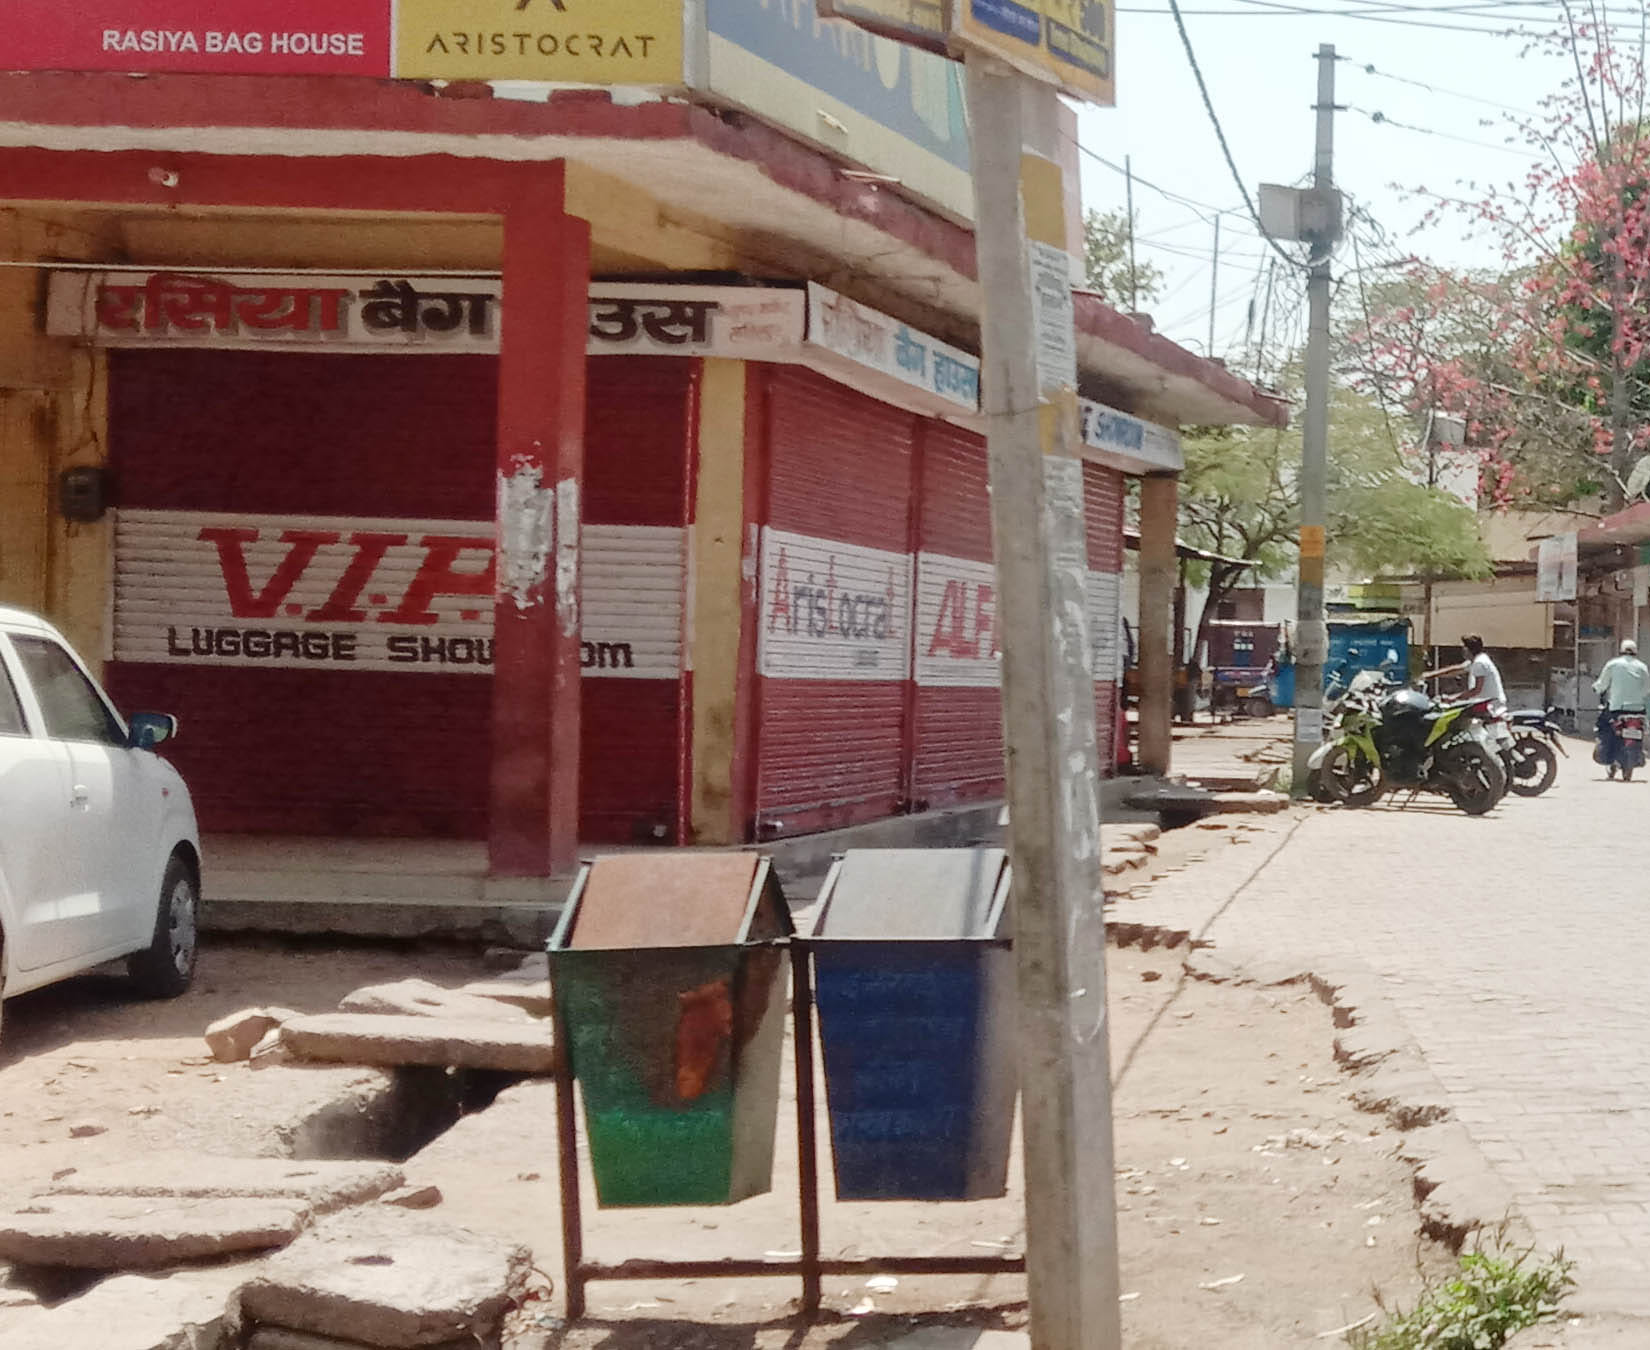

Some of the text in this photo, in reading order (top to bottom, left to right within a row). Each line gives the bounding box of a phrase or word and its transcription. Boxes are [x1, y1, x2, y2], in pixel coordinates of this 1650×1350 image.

[102, 30, 364, 57] RASIYA BAG HOUSE
[425, 32, 656, 58] ARISTOCRAT
[95, 273, 353, 337] रसिया
[357, 280, 498, 336] बैग
[587, 297, 718, 344] उस
[166, 627, 357, 661] LUGGAGE
